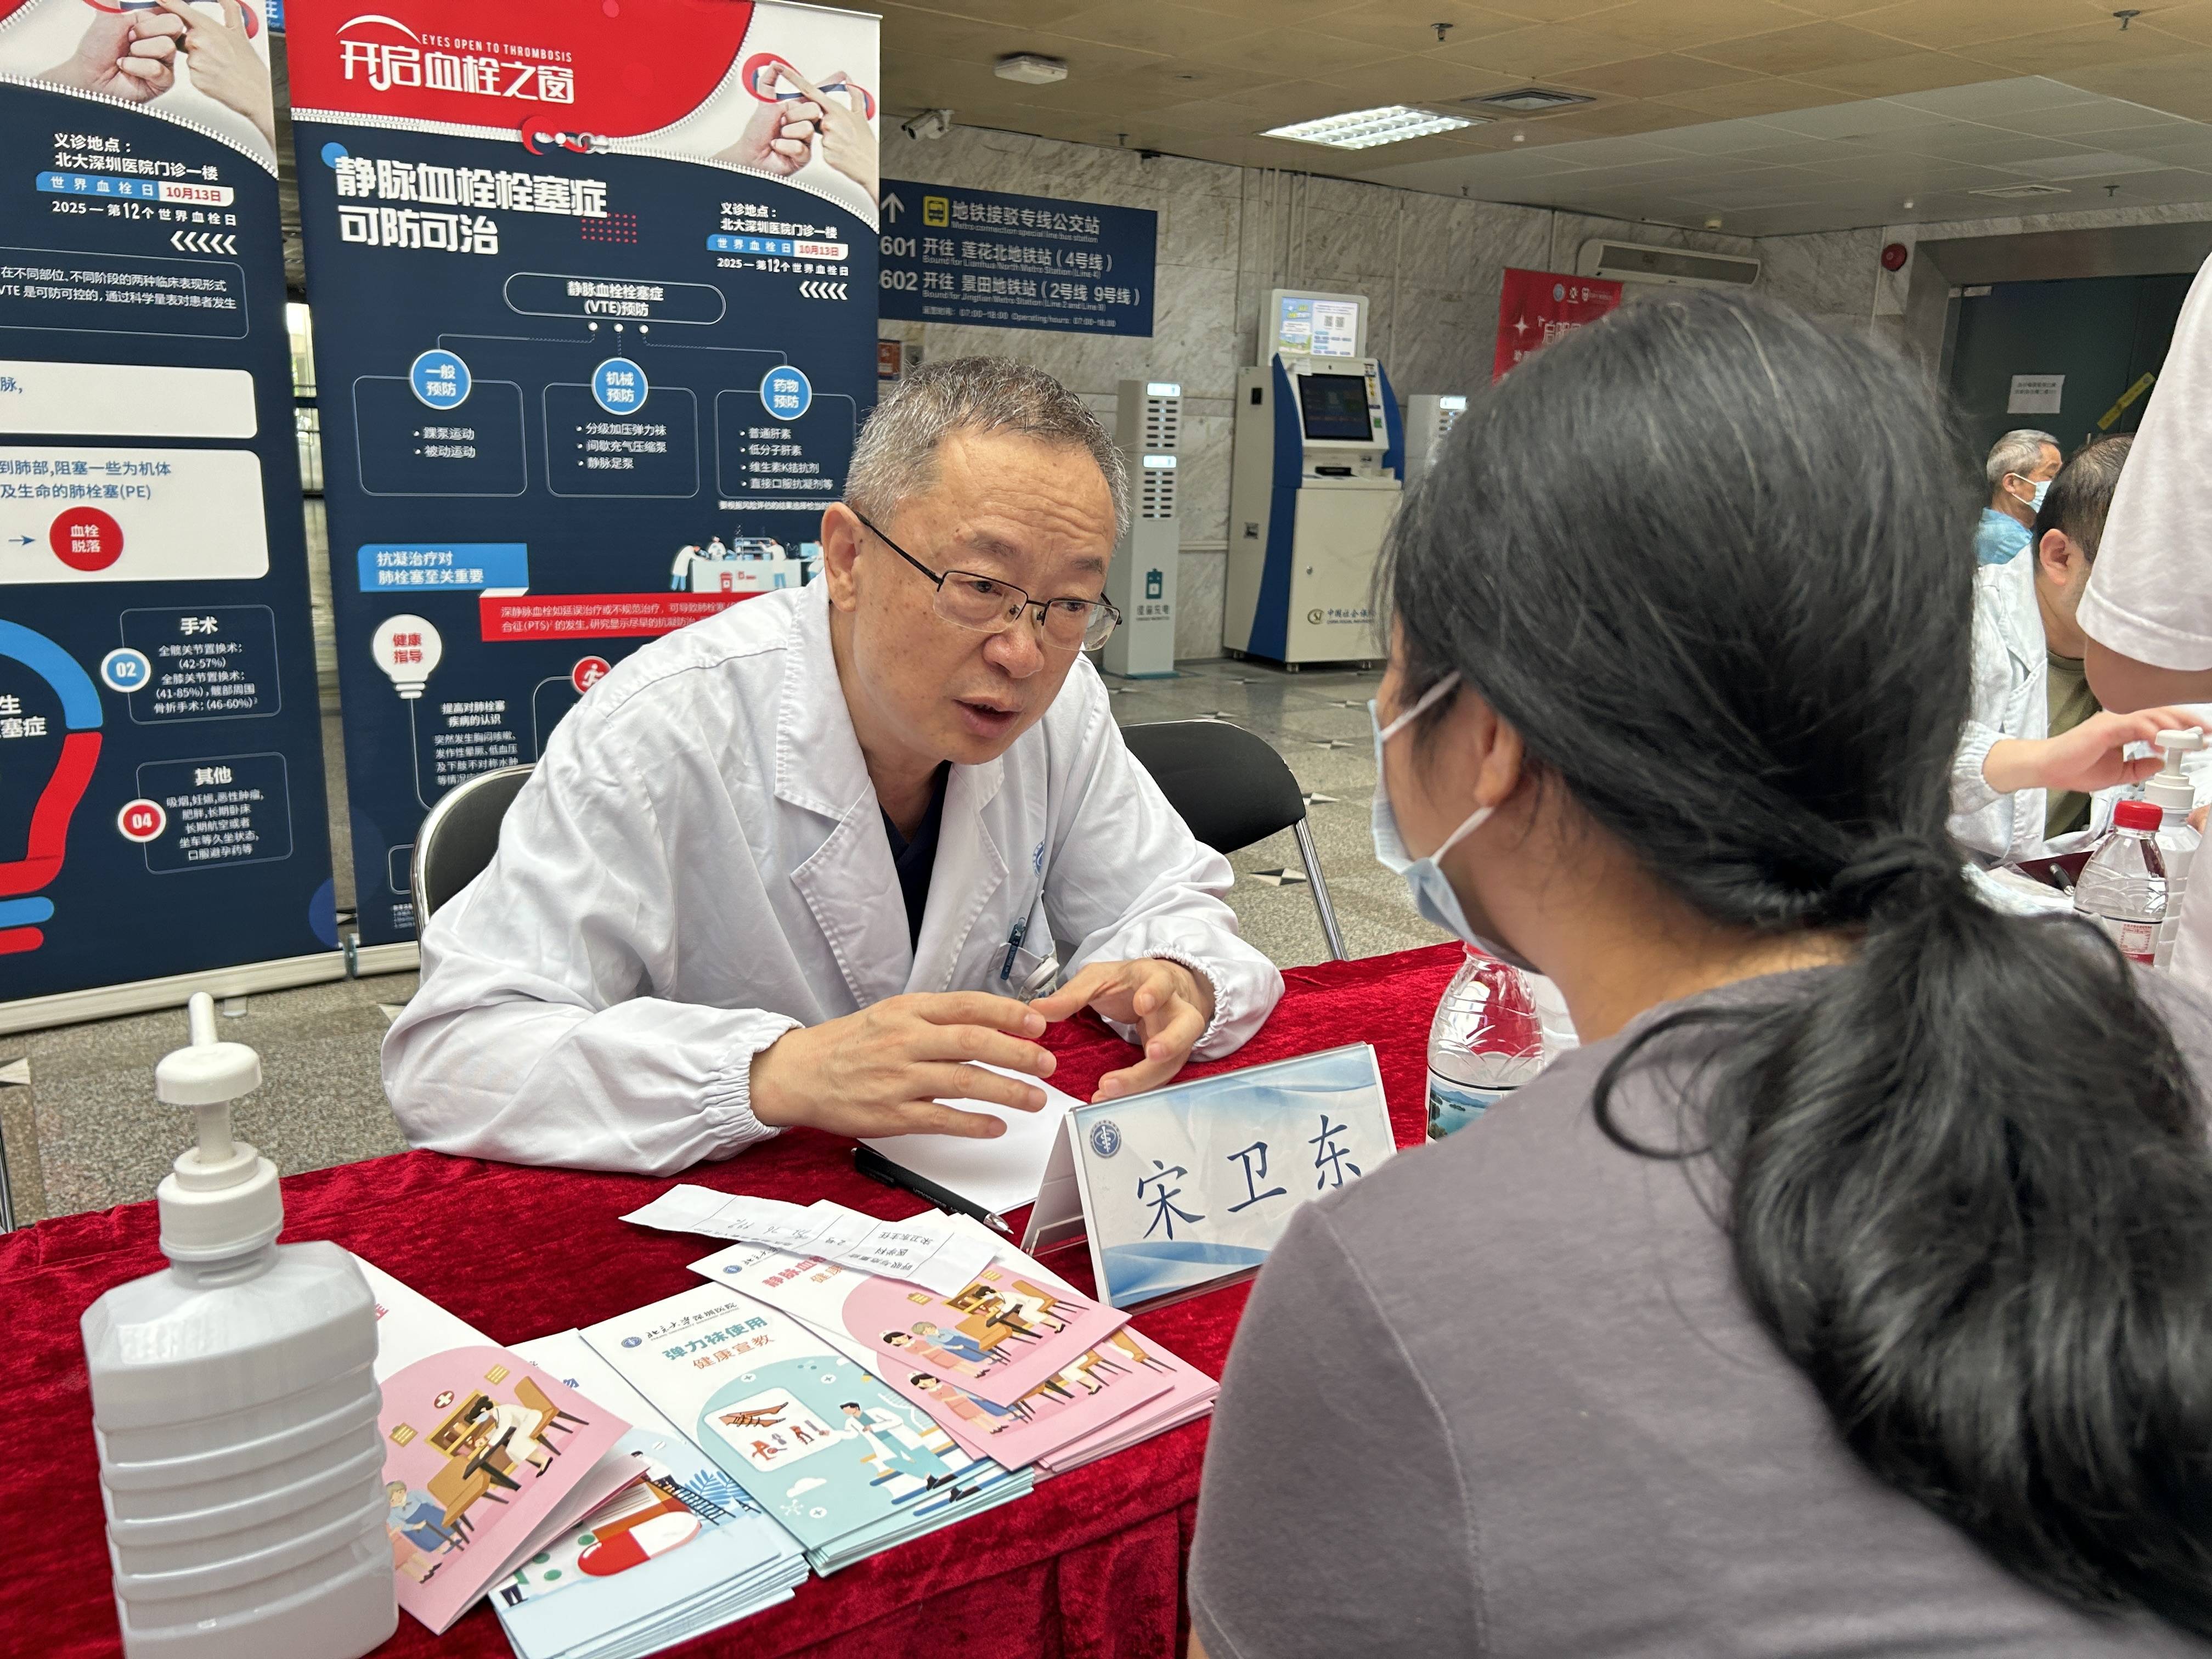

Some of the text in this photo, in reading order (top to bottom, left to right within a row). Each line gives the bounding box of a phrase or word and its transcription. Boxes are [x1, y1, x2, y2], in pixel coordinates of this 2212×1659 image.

[422, 33, 573, 63] EYES OPEN TO THROMBOSIS
[340, 40, 574, 104] 开启血栓之窗
[54, 132, 131, 153] 义诊地点：
[54, 151, 219, 181] 北大深圳医院门诊一楼
[50, 176, 221, 203] 世界血栓日 10月13日
[335, 156, 608, 218] 静脉血栓栓塞症
[720, 201, 777, 218] 义诊地点：
[952, 200, 1100, 234] 地铁接驳专线公交站
[337, 205, 499, 255] 可防可治
[720, 218, 838, 239] 北大深圳医院门诊一楼
[716, 238, 839, 256] 世界血栓日 10月13日
[880, 236, 916, 257] 601
[923, 237, 955, 256] 开往
[1, 266, 227, 292] 在不同部位、不同阶段的两种临床表现形式
[879, 270, 918, 291] 602
[923, 272, 955, 290] 开往
[567, 280, 664, 301] 静脉血栓栓塞症
[584, 299, 650, 317] (VTE)预防
[425, 363, 456, 380] 一般
[605, 371, 635, 387] 机械
[425, 381, 457, 397] 预防
[773, 378, 799, 393] 药物
[606, 387, 635, 403] 预防
[773, 394, 799, 409] 预防
[585, 422, 667, 437] 分级加压弹力袜
[748, 427, 792, 440] 普通肝素
[424, 444, 476, 459] 被动运动
[586, 439, 668, 453] 间歇充气压缩泵
[748, 443, 803, 456] 低分子肝素
[0, 460, 171, 476] 到肺部，阻塞一些为机体
[586, 456, 634, 470] 静脉足泵
[748, 460, 820, 474] 维生素K拮抗剂
[0, 484, 151, 500] 及生命的肺栓塞(PE)
[749, 477, 833, 490] 直接口服抗凝剂等
[70, 524, 100, 538] 血栓
[72, 540, 101, 553] 脱落
[376, 550, 454, 567] 抗凝治疗对
[377, 568, 484, 586] 肺栓塞至关重要
[180, 617, 218, 635] 手术
[392, 633, 422, 648] 健康
[179, 656, 227, 670] (42-57%)
[393, 649, 424, 664] 指导
[116, 662, 137, 678] 02
[0, 695, 21, 714] 生
[442, 700, 505, 715] 提高对肺栓塞
[1, 715, 47, 738] 塞症
[448, 714, 501, 729] 疾病的认识
[436, 757, 518, 773] 及下肢不对称水肿
[195, 766, 233, 786] 其他
[132, 813, 153, 830] 04
[188, 843, 253, 861] 口服避孕药等
[1137, 1113, 1362, 1241] 宋卫东
[662, 1316, 768, 1361] 弹力袜使用
[693, 1334, 774, 1369] 健康宣教
